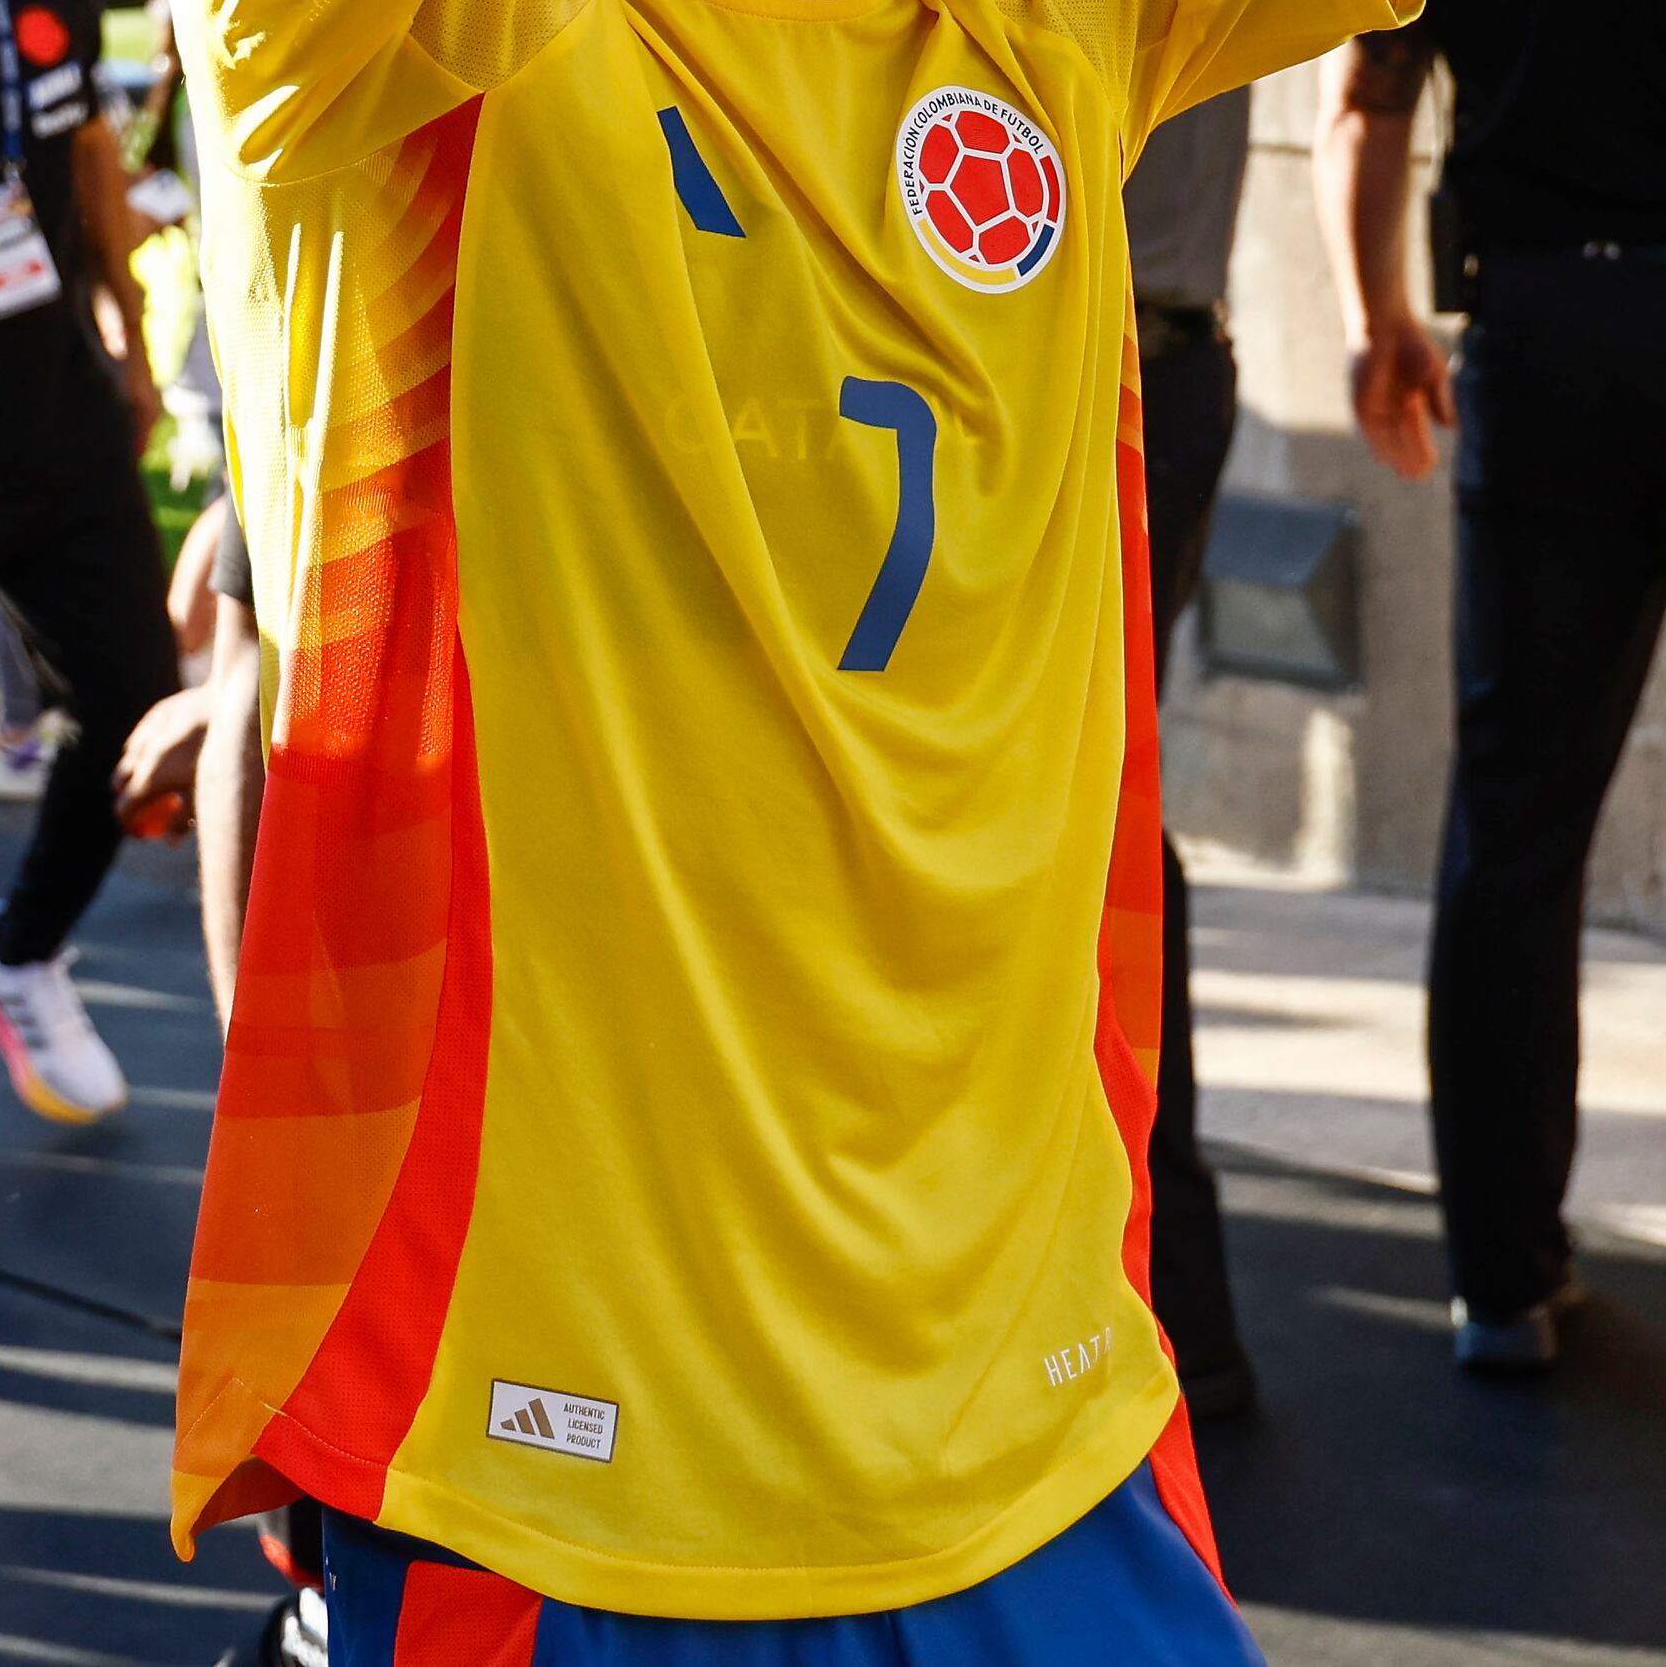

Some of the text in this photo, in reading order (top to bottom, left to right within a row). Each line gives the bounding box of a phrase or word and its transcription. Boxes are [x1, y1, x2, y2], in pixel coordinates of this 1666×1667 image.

[914, 92, 982, 129] COLOMBIANA
[983, 99, 999, 115] DE
[837, 374, 937, 672] 7
[563, 1402, 606, 1420] AUTHENTIC
[567, 1419, 604, 1435] LICENSED
[566, 1433, 602, 1449] PRODUCT
